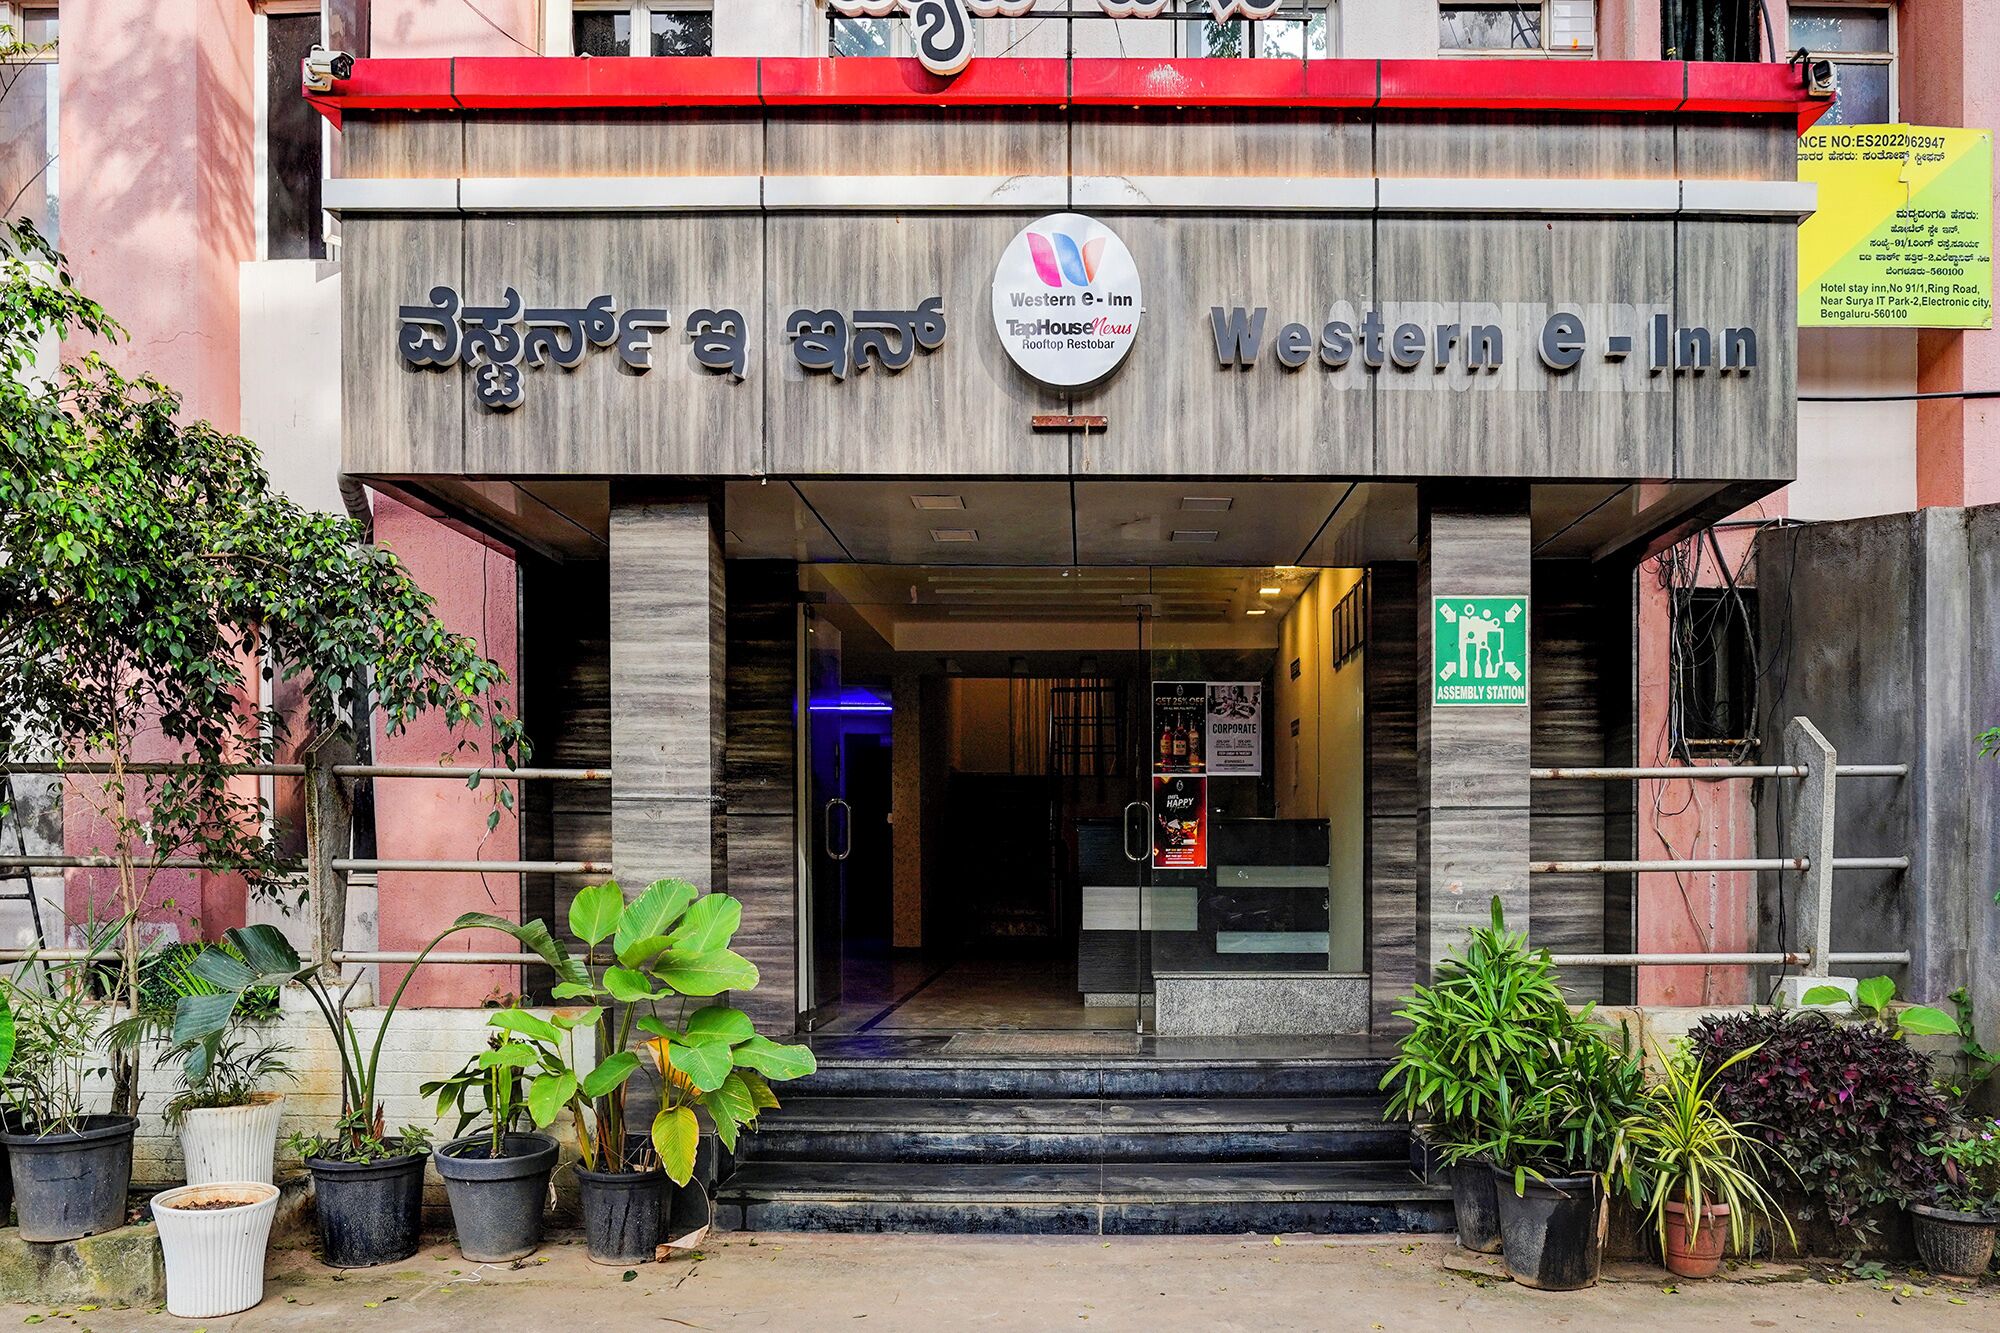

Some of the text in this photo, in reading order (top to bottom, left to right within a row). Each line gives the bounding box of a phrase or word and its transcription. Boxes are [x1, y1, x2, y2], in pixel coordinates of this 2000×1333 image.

[1820, 283, 1846, 293] Hotel
[1848, 284, 1868, 294] stay
[1952, 284, 1980, 295] Road,
[1010, 292, 1076, 307] Western
[1820, 296, 1843, 305] Near
[1846, 296, 1873, 307] Surya
[1876, 296, 1885, 305] IT
[1972, 297, 1991, 308] city,
[1820, 309, 1908, 320] Bengaluru-560100
[1210, 306, 1504, 369] Western
[398, 286, 946, 409] ವೆಸ್ಟರ್ನ್ ಇ ಇನ್
[1022, 339, 1115, 351] Rooftop Restobar
[1437, 686, 1524, 699] ASSEMBLY STATION
[1155, 697, 1205, 706] GET 25% OFF
[1212, 723, 1257, 734] CORPORATE
[1166, 797, 1194, 808] HAPPY
